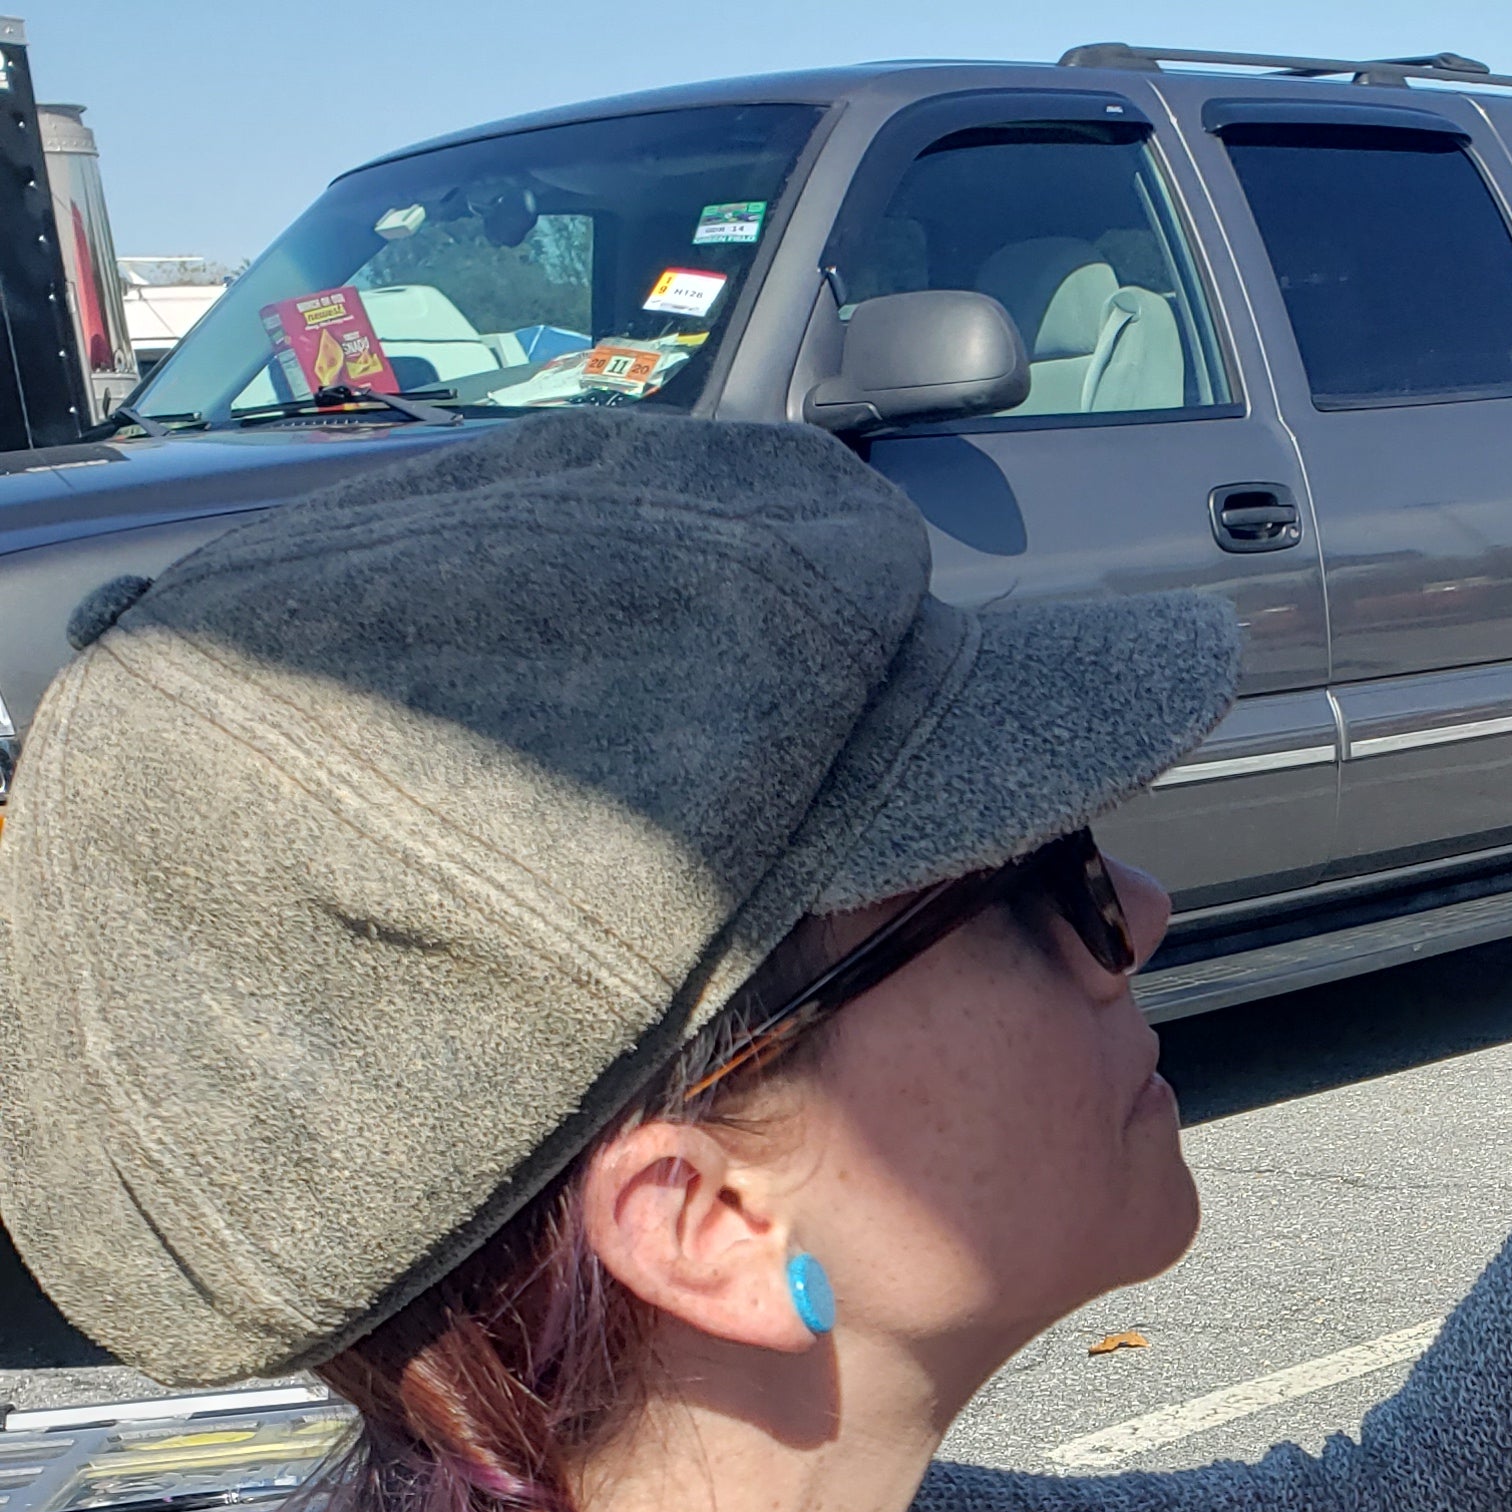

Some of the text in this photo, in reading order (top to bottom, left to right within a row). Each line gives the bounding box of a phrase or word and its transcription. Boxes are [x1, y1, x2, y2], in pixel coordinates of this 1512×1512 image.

[588, 358, 650, 375] 20 11 20
